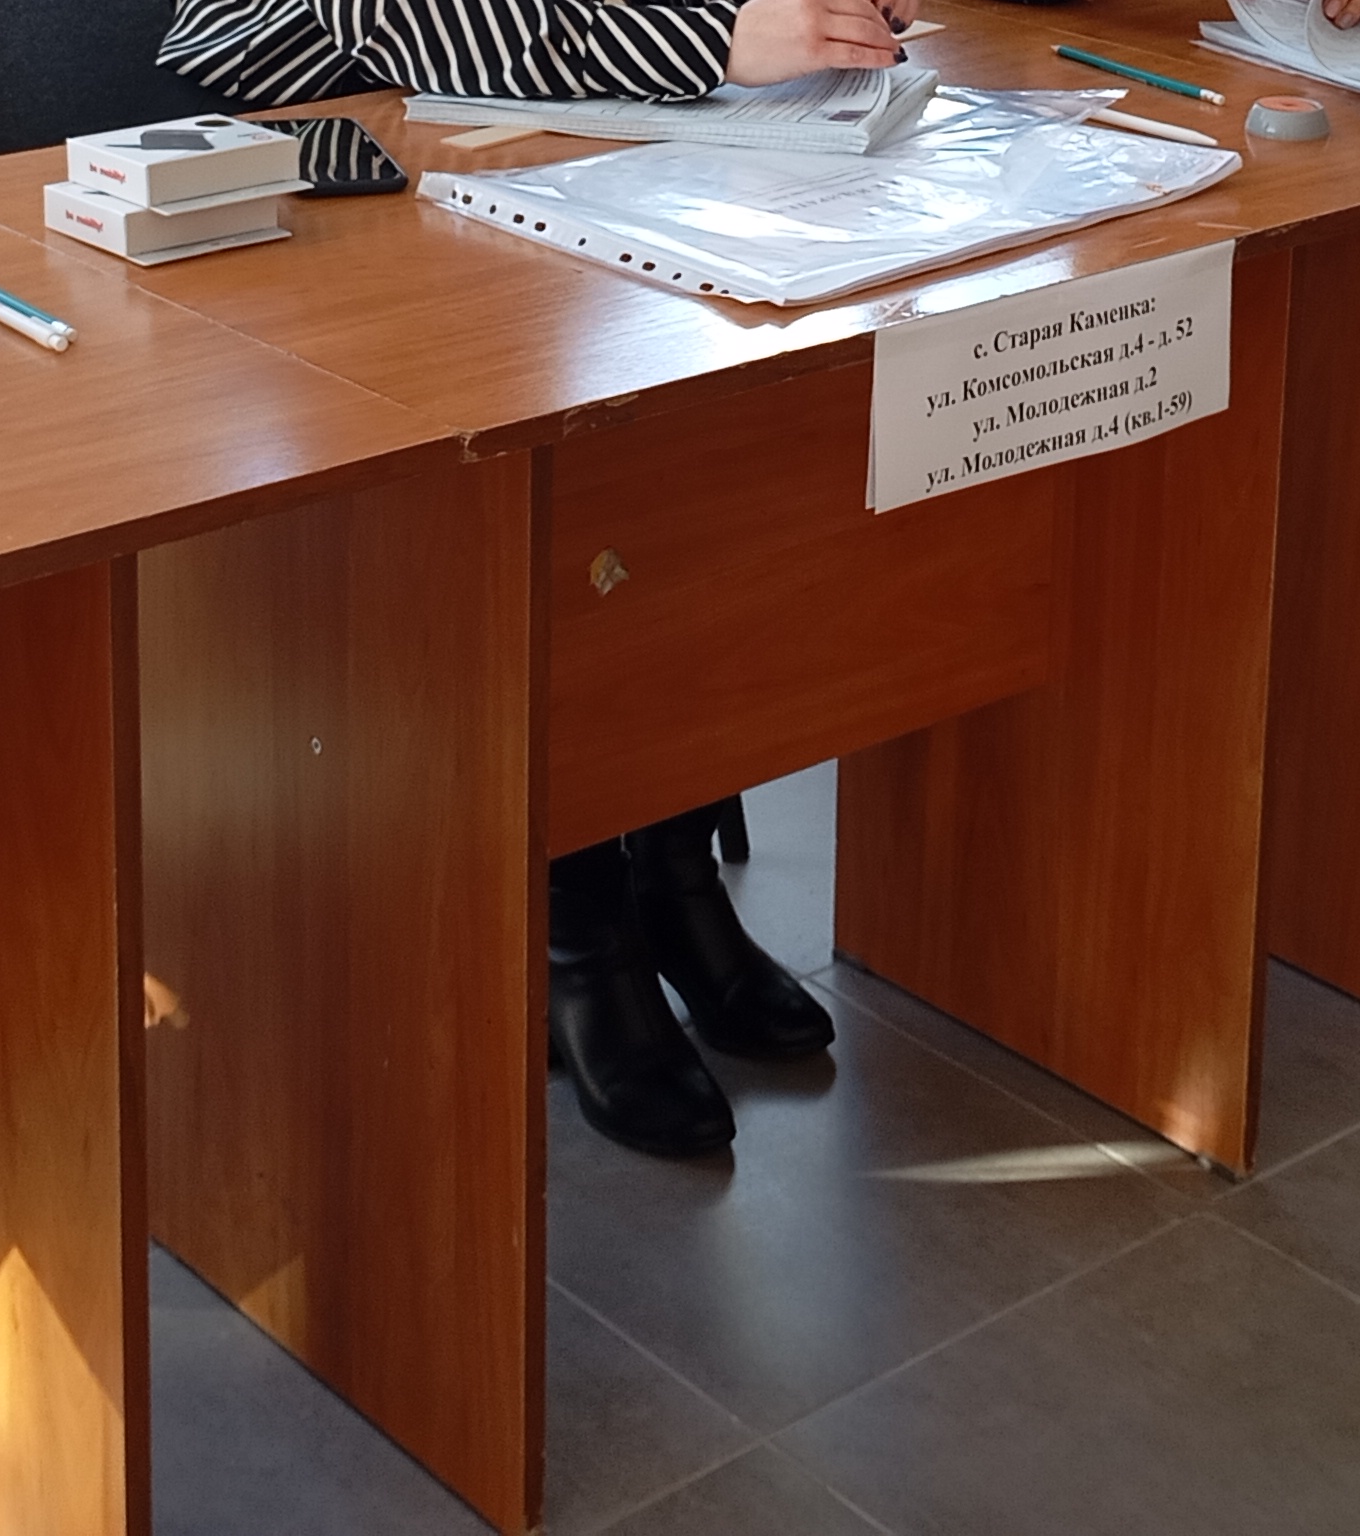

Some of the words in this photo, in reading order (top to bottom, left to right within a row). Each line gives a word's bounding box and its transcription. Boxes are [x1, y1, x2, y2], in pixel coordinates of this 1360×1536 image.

[926, 390, 957, 418] ул.
[962, 346, 1114, 403] Комсомольская
[1118, 332, 1144, 361] д.4
[1157, 330, 1173, 349] д.
[1175, 316, 1194, 341] 52
[973, 343, 989, 360] с.
[993, 321, 1063, 353] Старая
[1069, 297, 1156, 334] Каменка:
[972, 416, 1001, 443] ул.
[1005, 380, 1130, 428] Молодежная
[1133, 365, 1158, 395] д.2
[925, 466, 956, 493] ул.
[960, 428, 1087, 478] Молодежная
[1091, 414, 1121, 444] д.4
